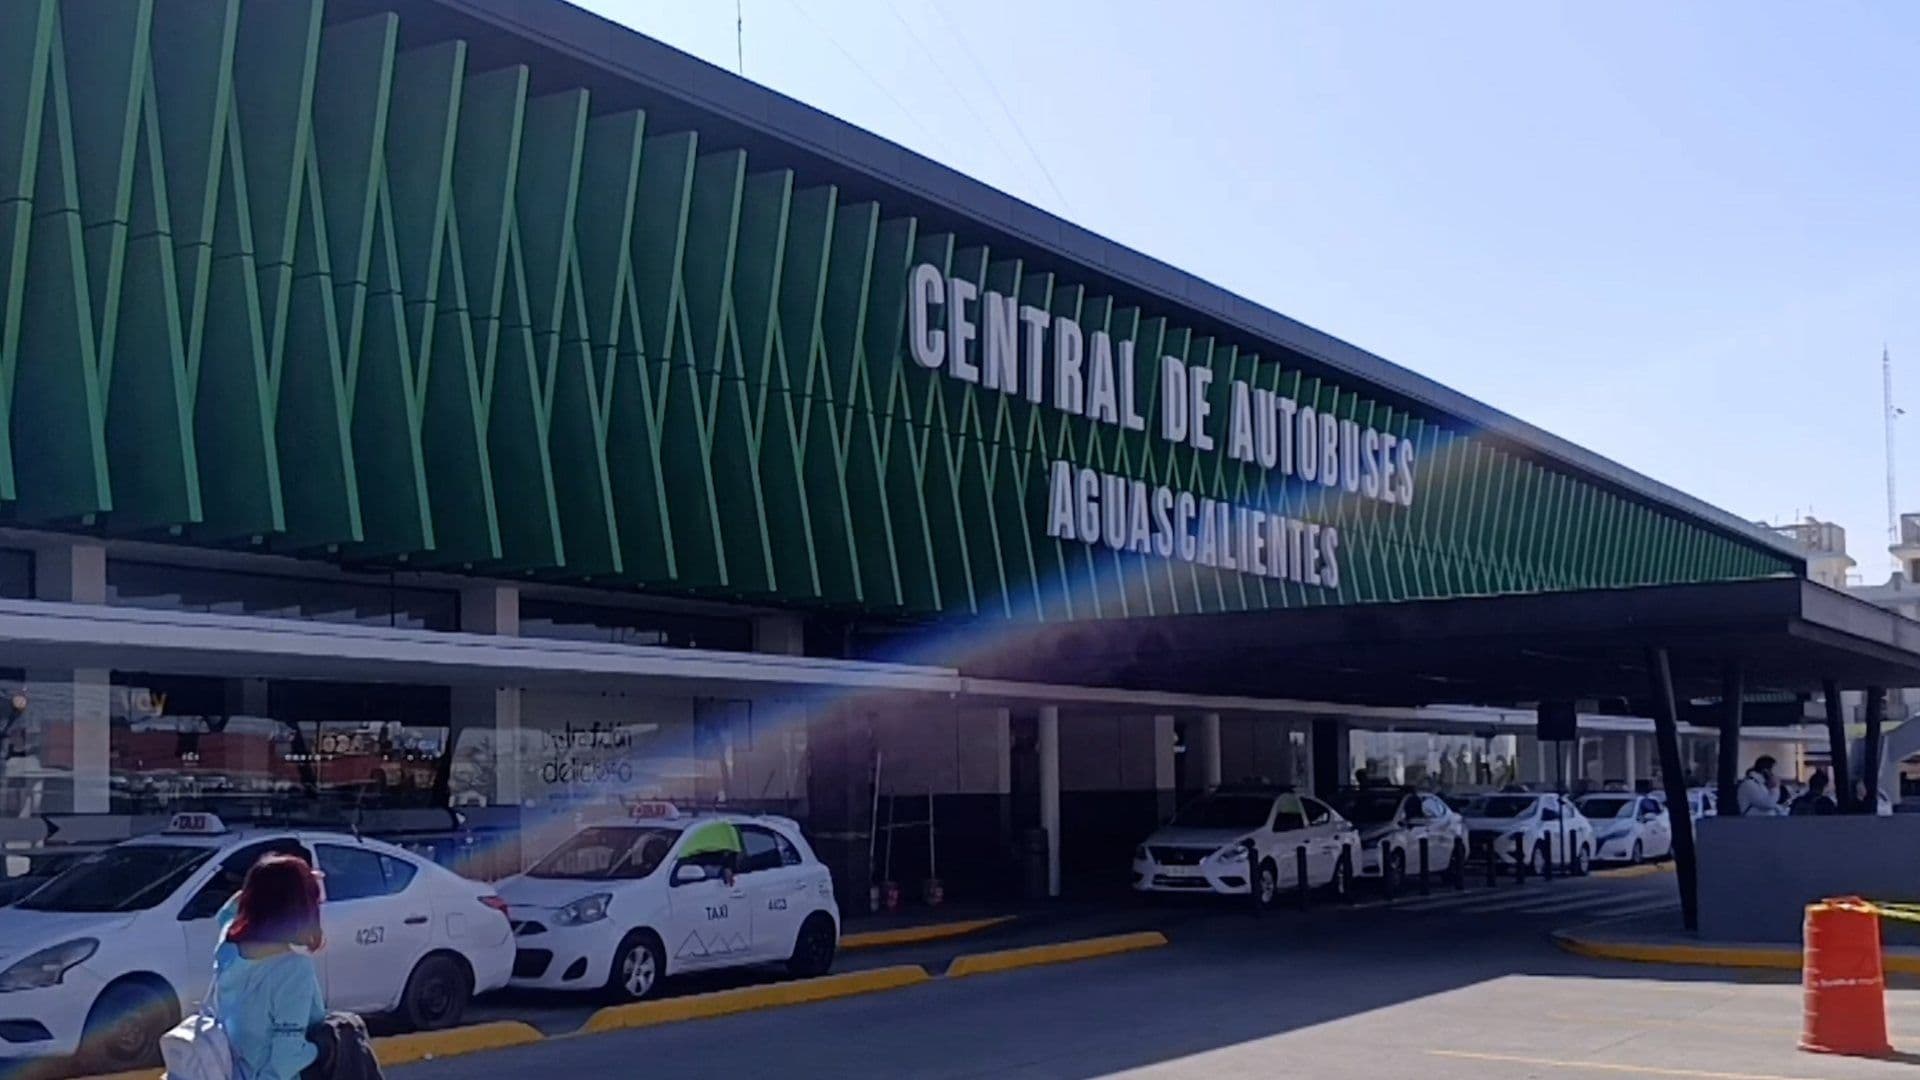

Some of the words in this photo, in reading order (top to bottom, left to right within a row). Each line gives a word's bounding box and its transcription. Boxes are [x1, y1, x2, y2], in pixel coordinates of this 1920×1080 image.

[909, 263, 1144, 431] CENTRAL
[1161, 354, 1214, 450] DE
[1229, 379, 1414, 506] AUTOBUSES
[1047, 460, 1339, 588] AGUASCALIENTES
[356, 926, 385, 946] 4257
[705, 904, 729, 921] TAXI
